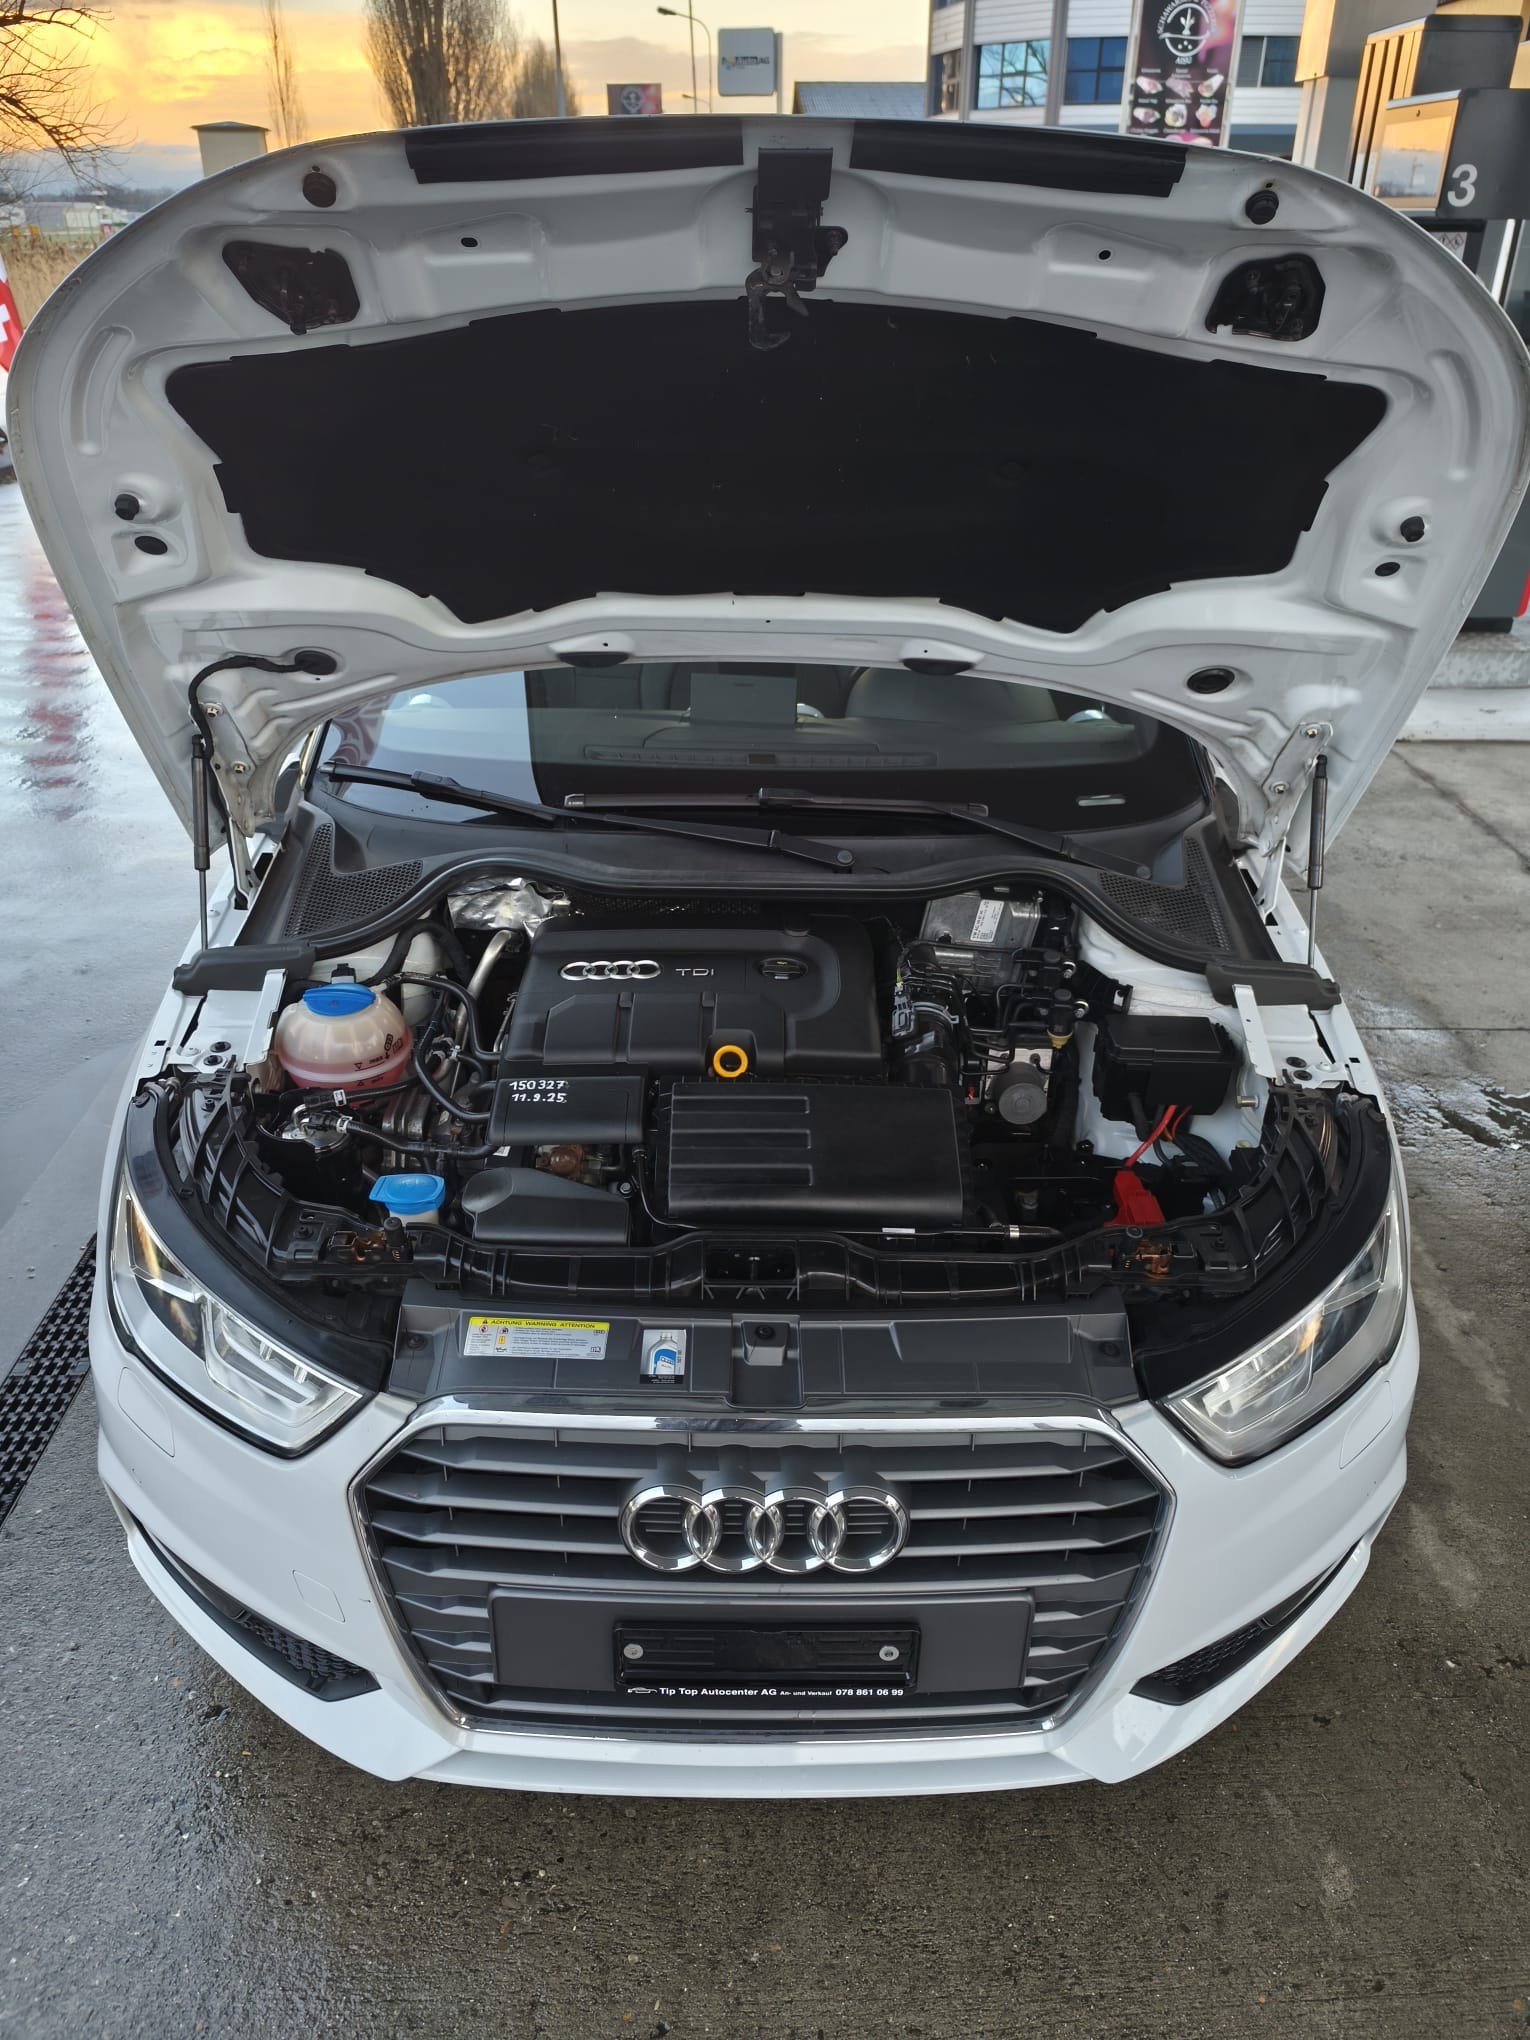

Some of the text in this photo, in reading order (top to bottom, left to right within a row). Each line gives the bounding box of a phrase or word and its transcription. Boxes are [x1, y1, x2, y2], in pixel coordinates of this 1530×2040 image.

[1447, 163, 1478, 208] 3
[675, 968, 715, 977] TDI
[659, 1687, 676, 1697] Tip
[678, 1687, 699, 1697] Top
[700, 1688, 759, 1696] Autocenter
[760, 1688, 778, 1696] AG
[835, 1688, 854, 1696] 078
[855, 1688, 874, 1696] 861
[876, 1688, 889, 1696] 06
[891, 1688, 904, 1697] 99
